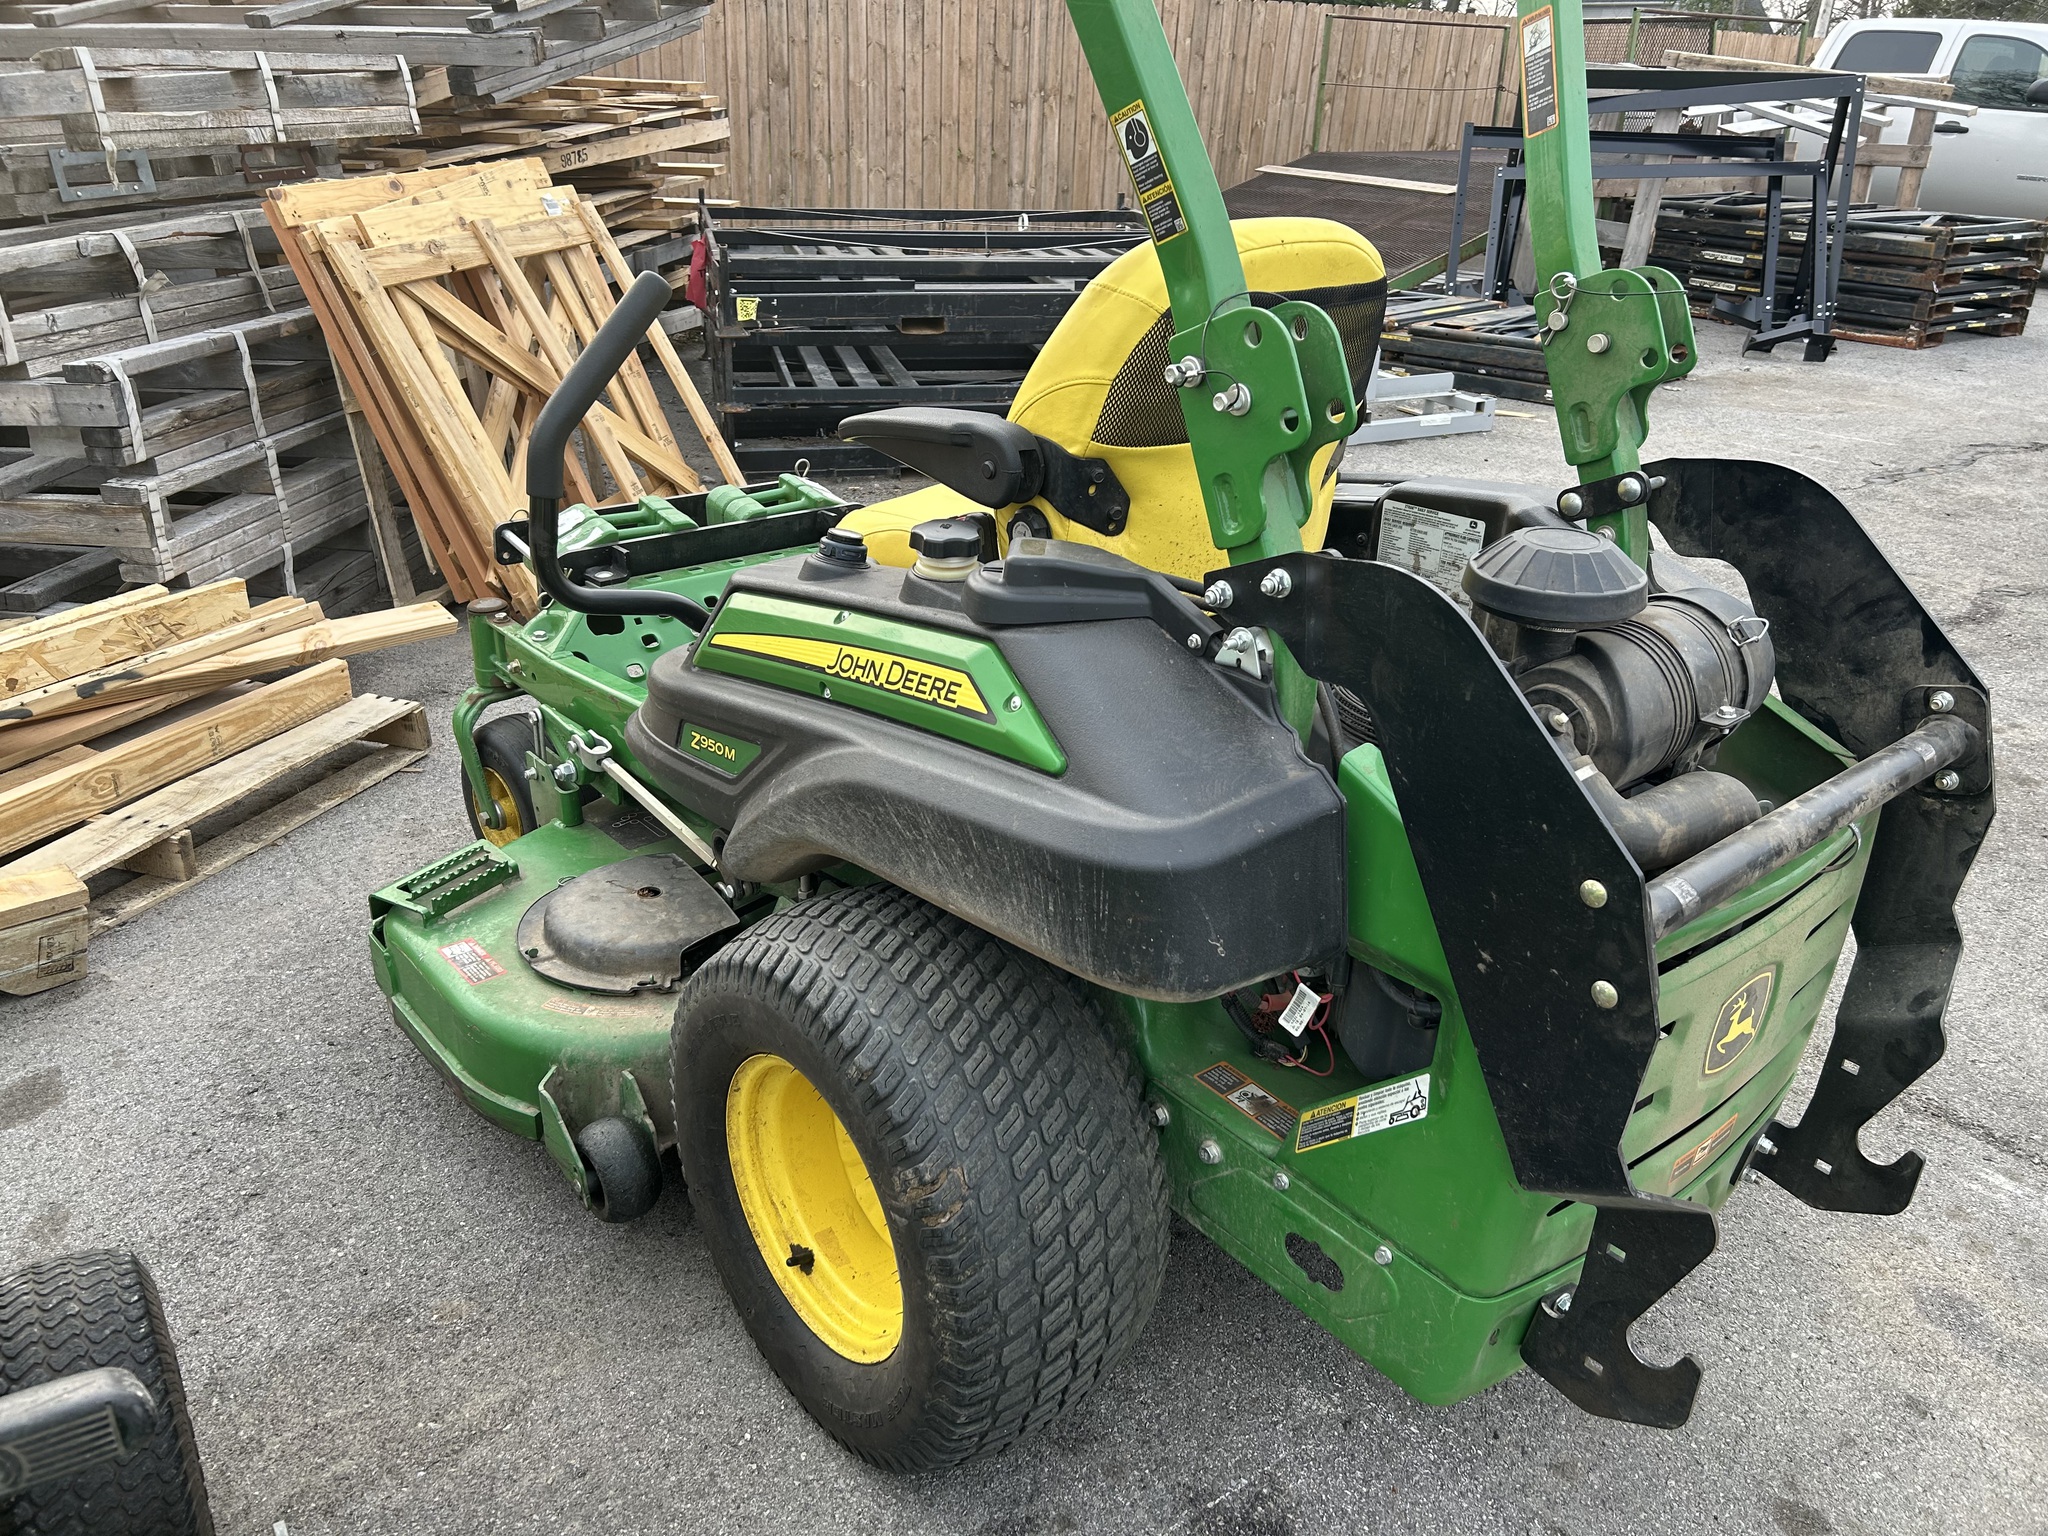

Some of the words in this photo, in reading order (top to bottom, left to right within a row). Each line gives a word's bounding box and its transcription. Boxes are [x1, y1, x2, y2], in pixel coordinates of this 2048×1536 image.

[1118, 103, 1141, 120] CAUTION
[1146, 183, 1172, 202] ATENCIÓN
[826, 648, 884, 682] JOHN
[885, 660, 962, 703] DEERE
[690, 731, 736, 762] Z950M
